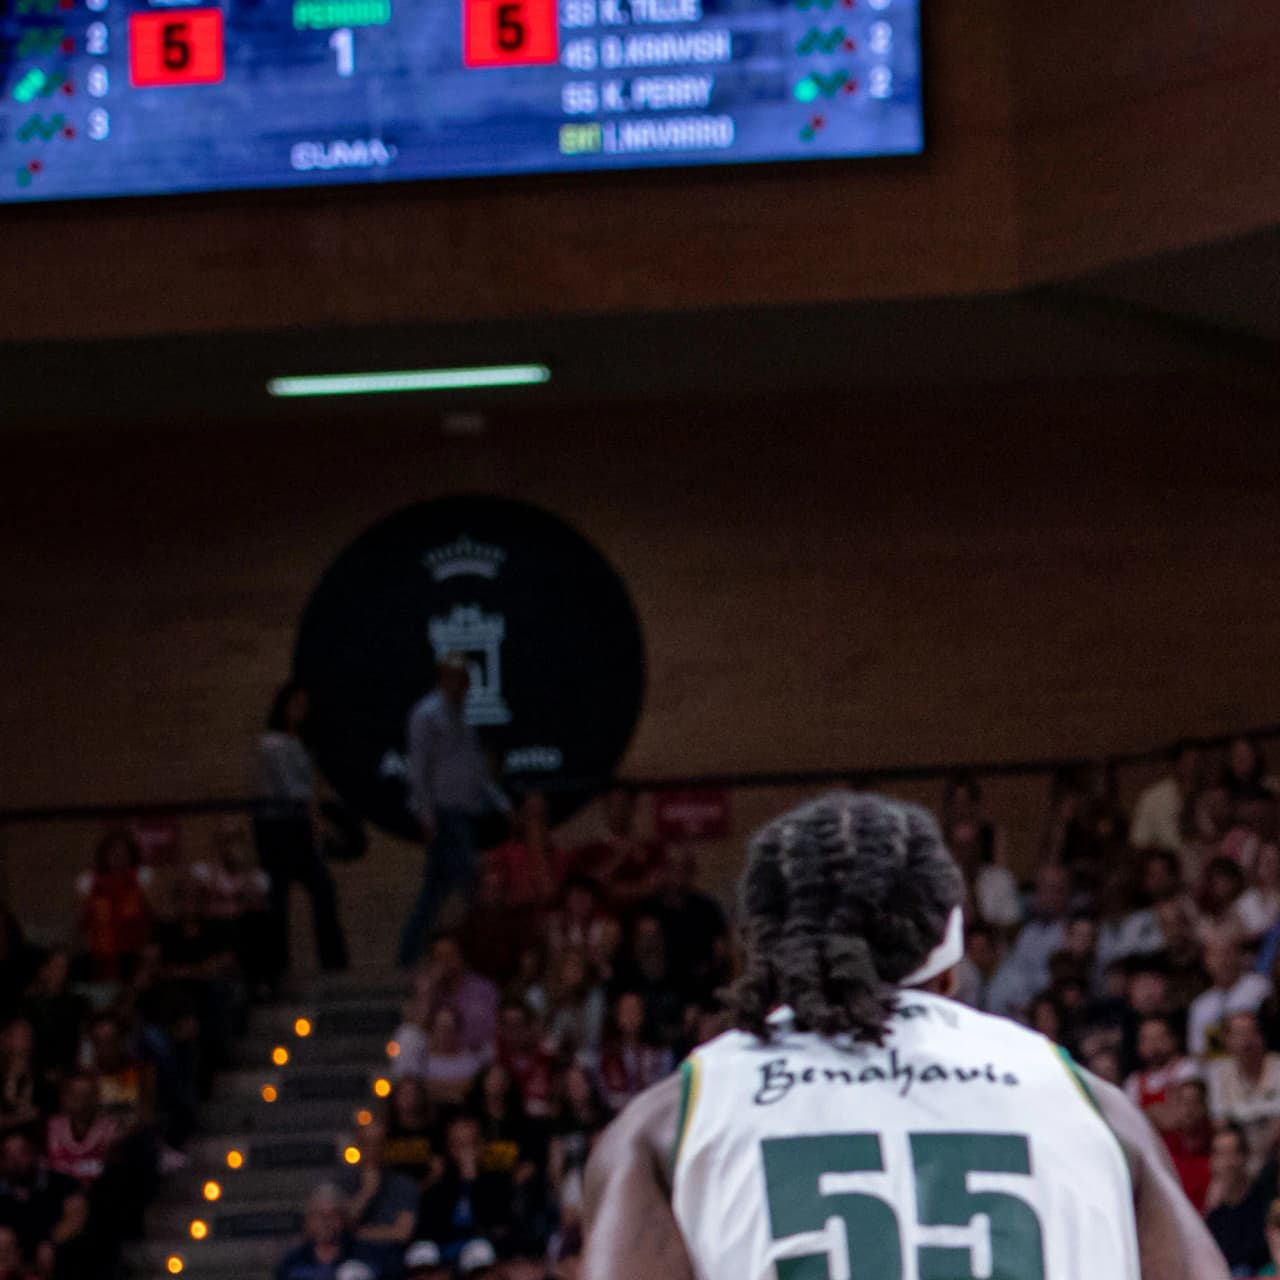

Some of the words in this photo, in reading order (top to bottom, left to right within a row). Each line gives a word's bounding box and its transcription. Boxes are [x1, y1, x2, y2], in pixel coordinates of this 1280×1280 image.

[163, 25, 190, 69] 5
[497, 2, 523, 51] 5
[330, 28, 355, 76] 1
